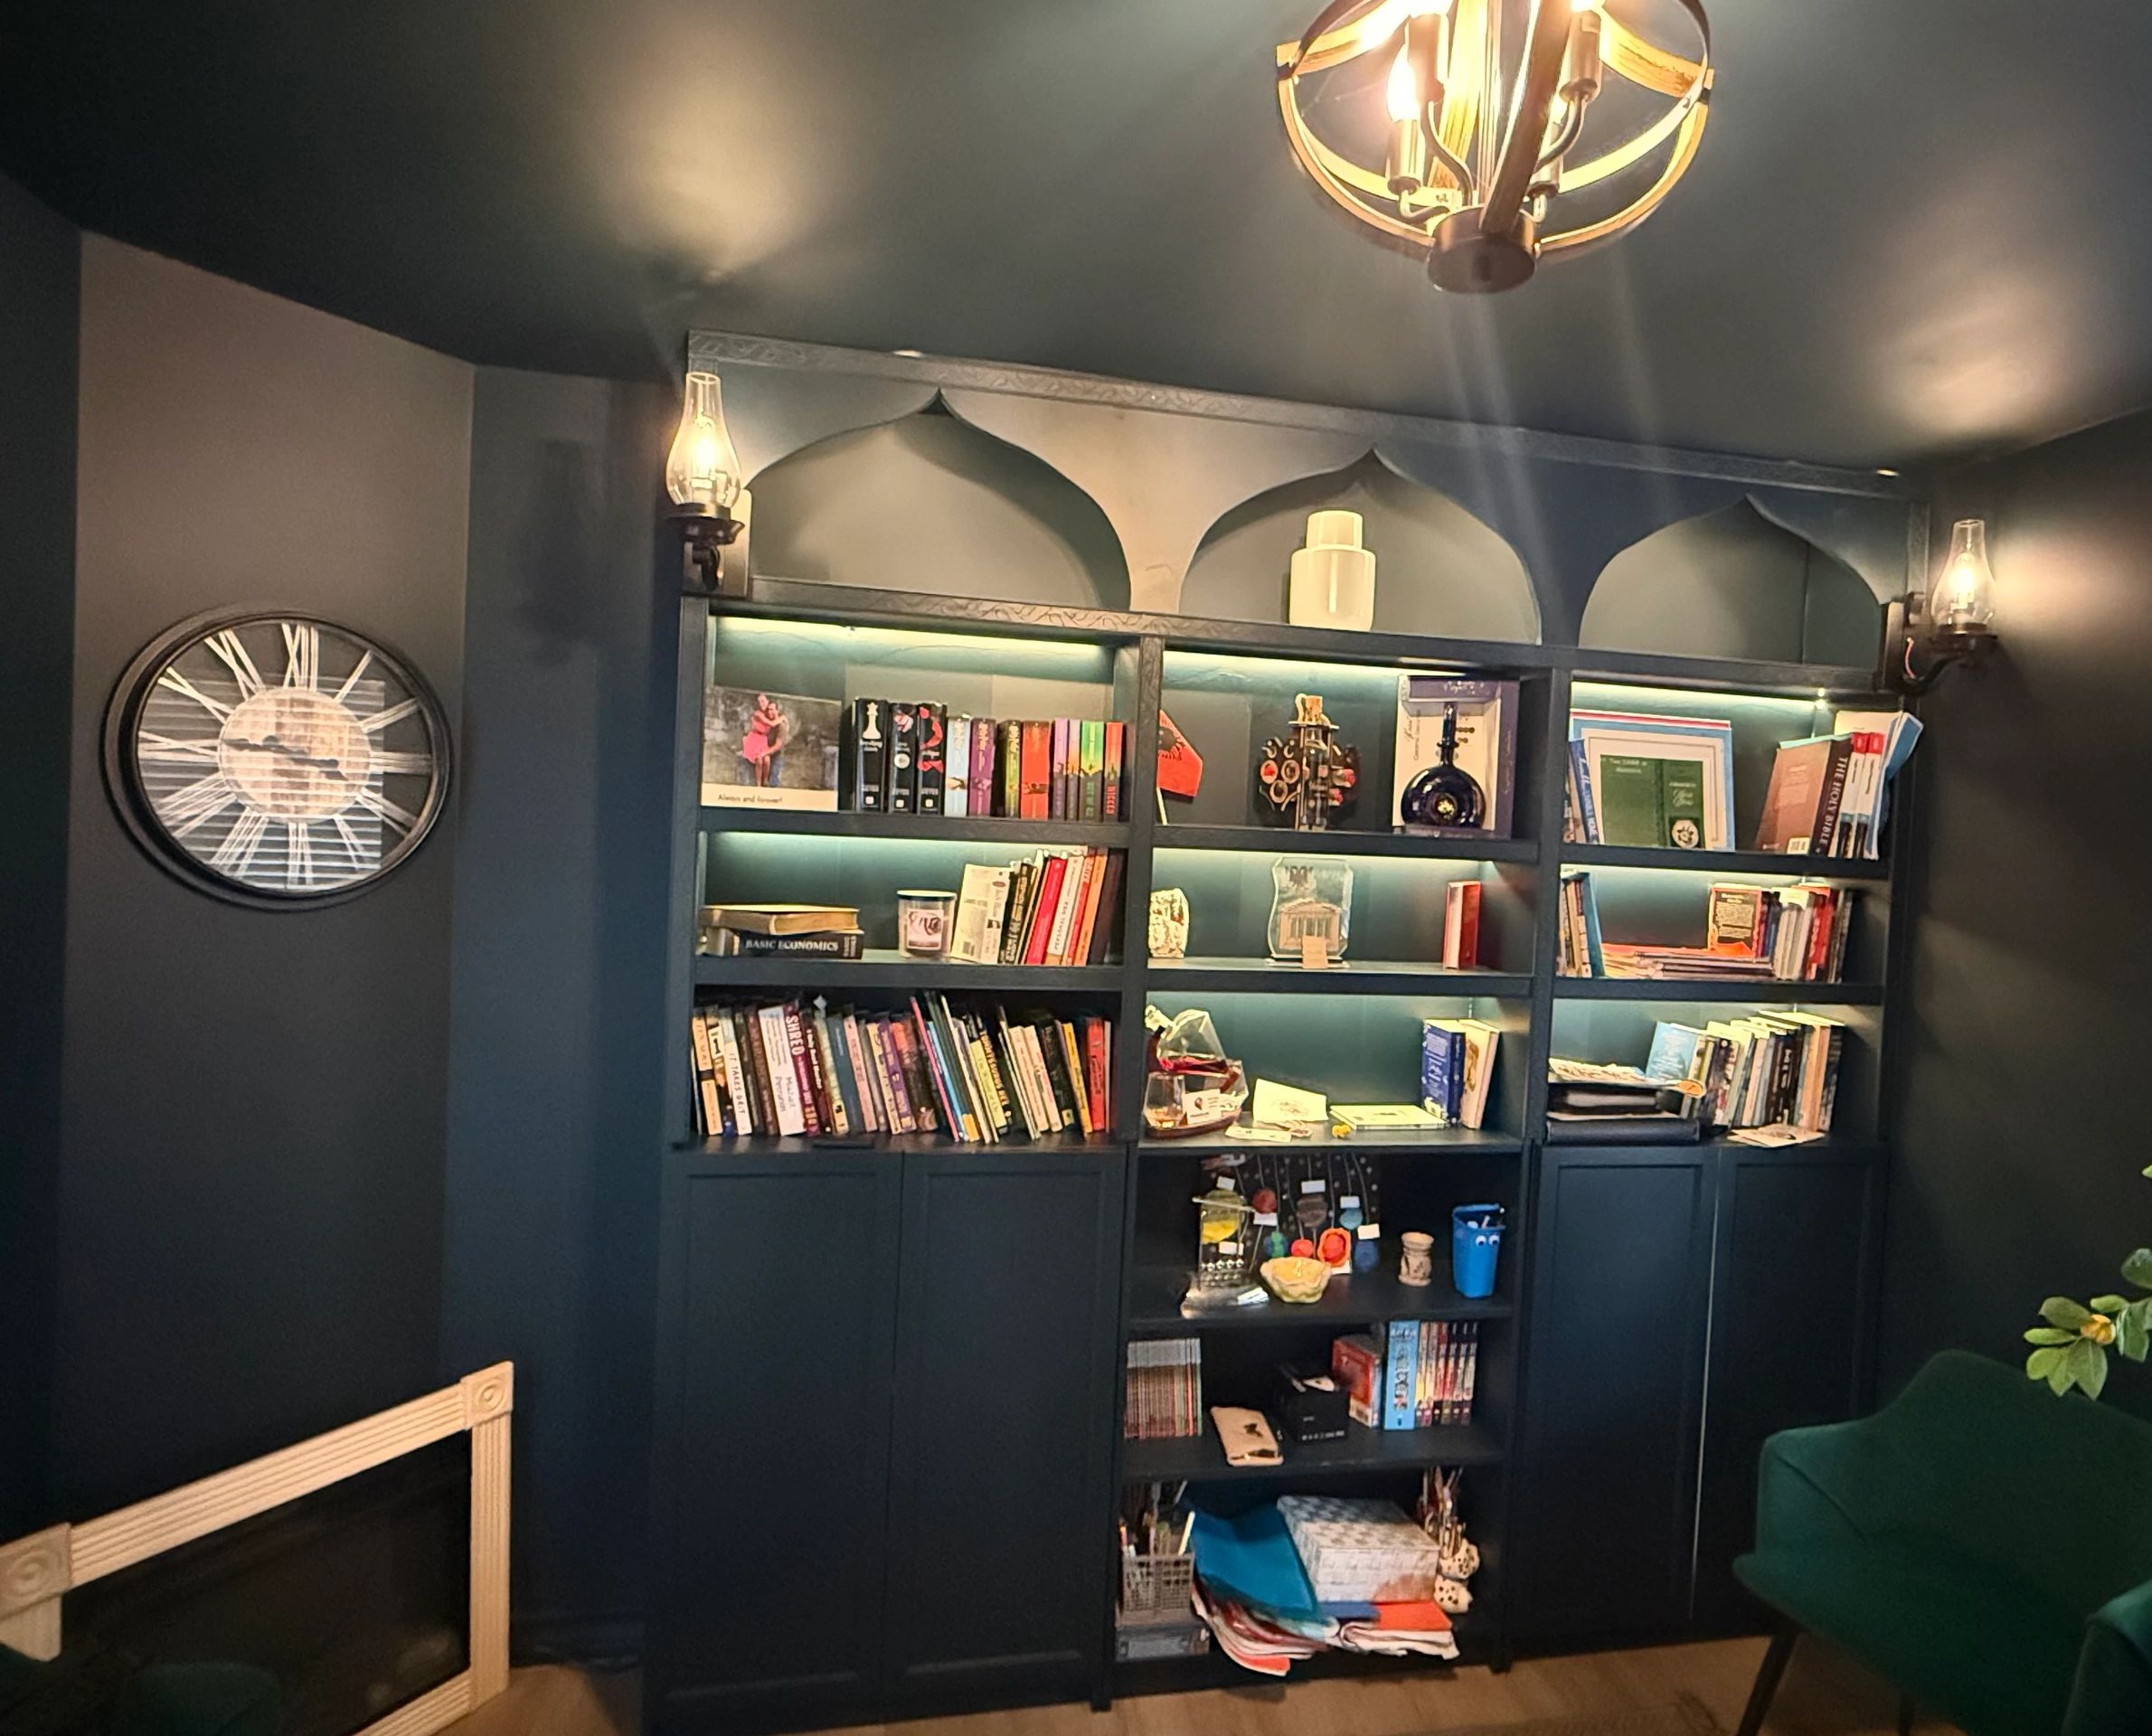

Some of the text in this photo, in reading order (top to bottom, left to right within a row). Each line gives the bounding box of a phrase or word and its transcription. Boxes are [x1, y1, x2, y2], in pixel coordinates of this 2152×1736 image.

[718, 794, 741, 803] Always
[742, 795, 755, 803] and
[1817, 755, 1848, 846] THE HOLY BIBLE
[745, 939, 776, 949] BASIC
[778, 939, 839, 952] ECONOMICS
[784, 1014, 806, 1056] SHRED
[806, 1033, 815, 1049] Only
[809, 1049, 818, 1064] Read
[728, 1052, 746, 1115] IT TAKES GRIT
[812, 1065, 824, 1090] Murder
